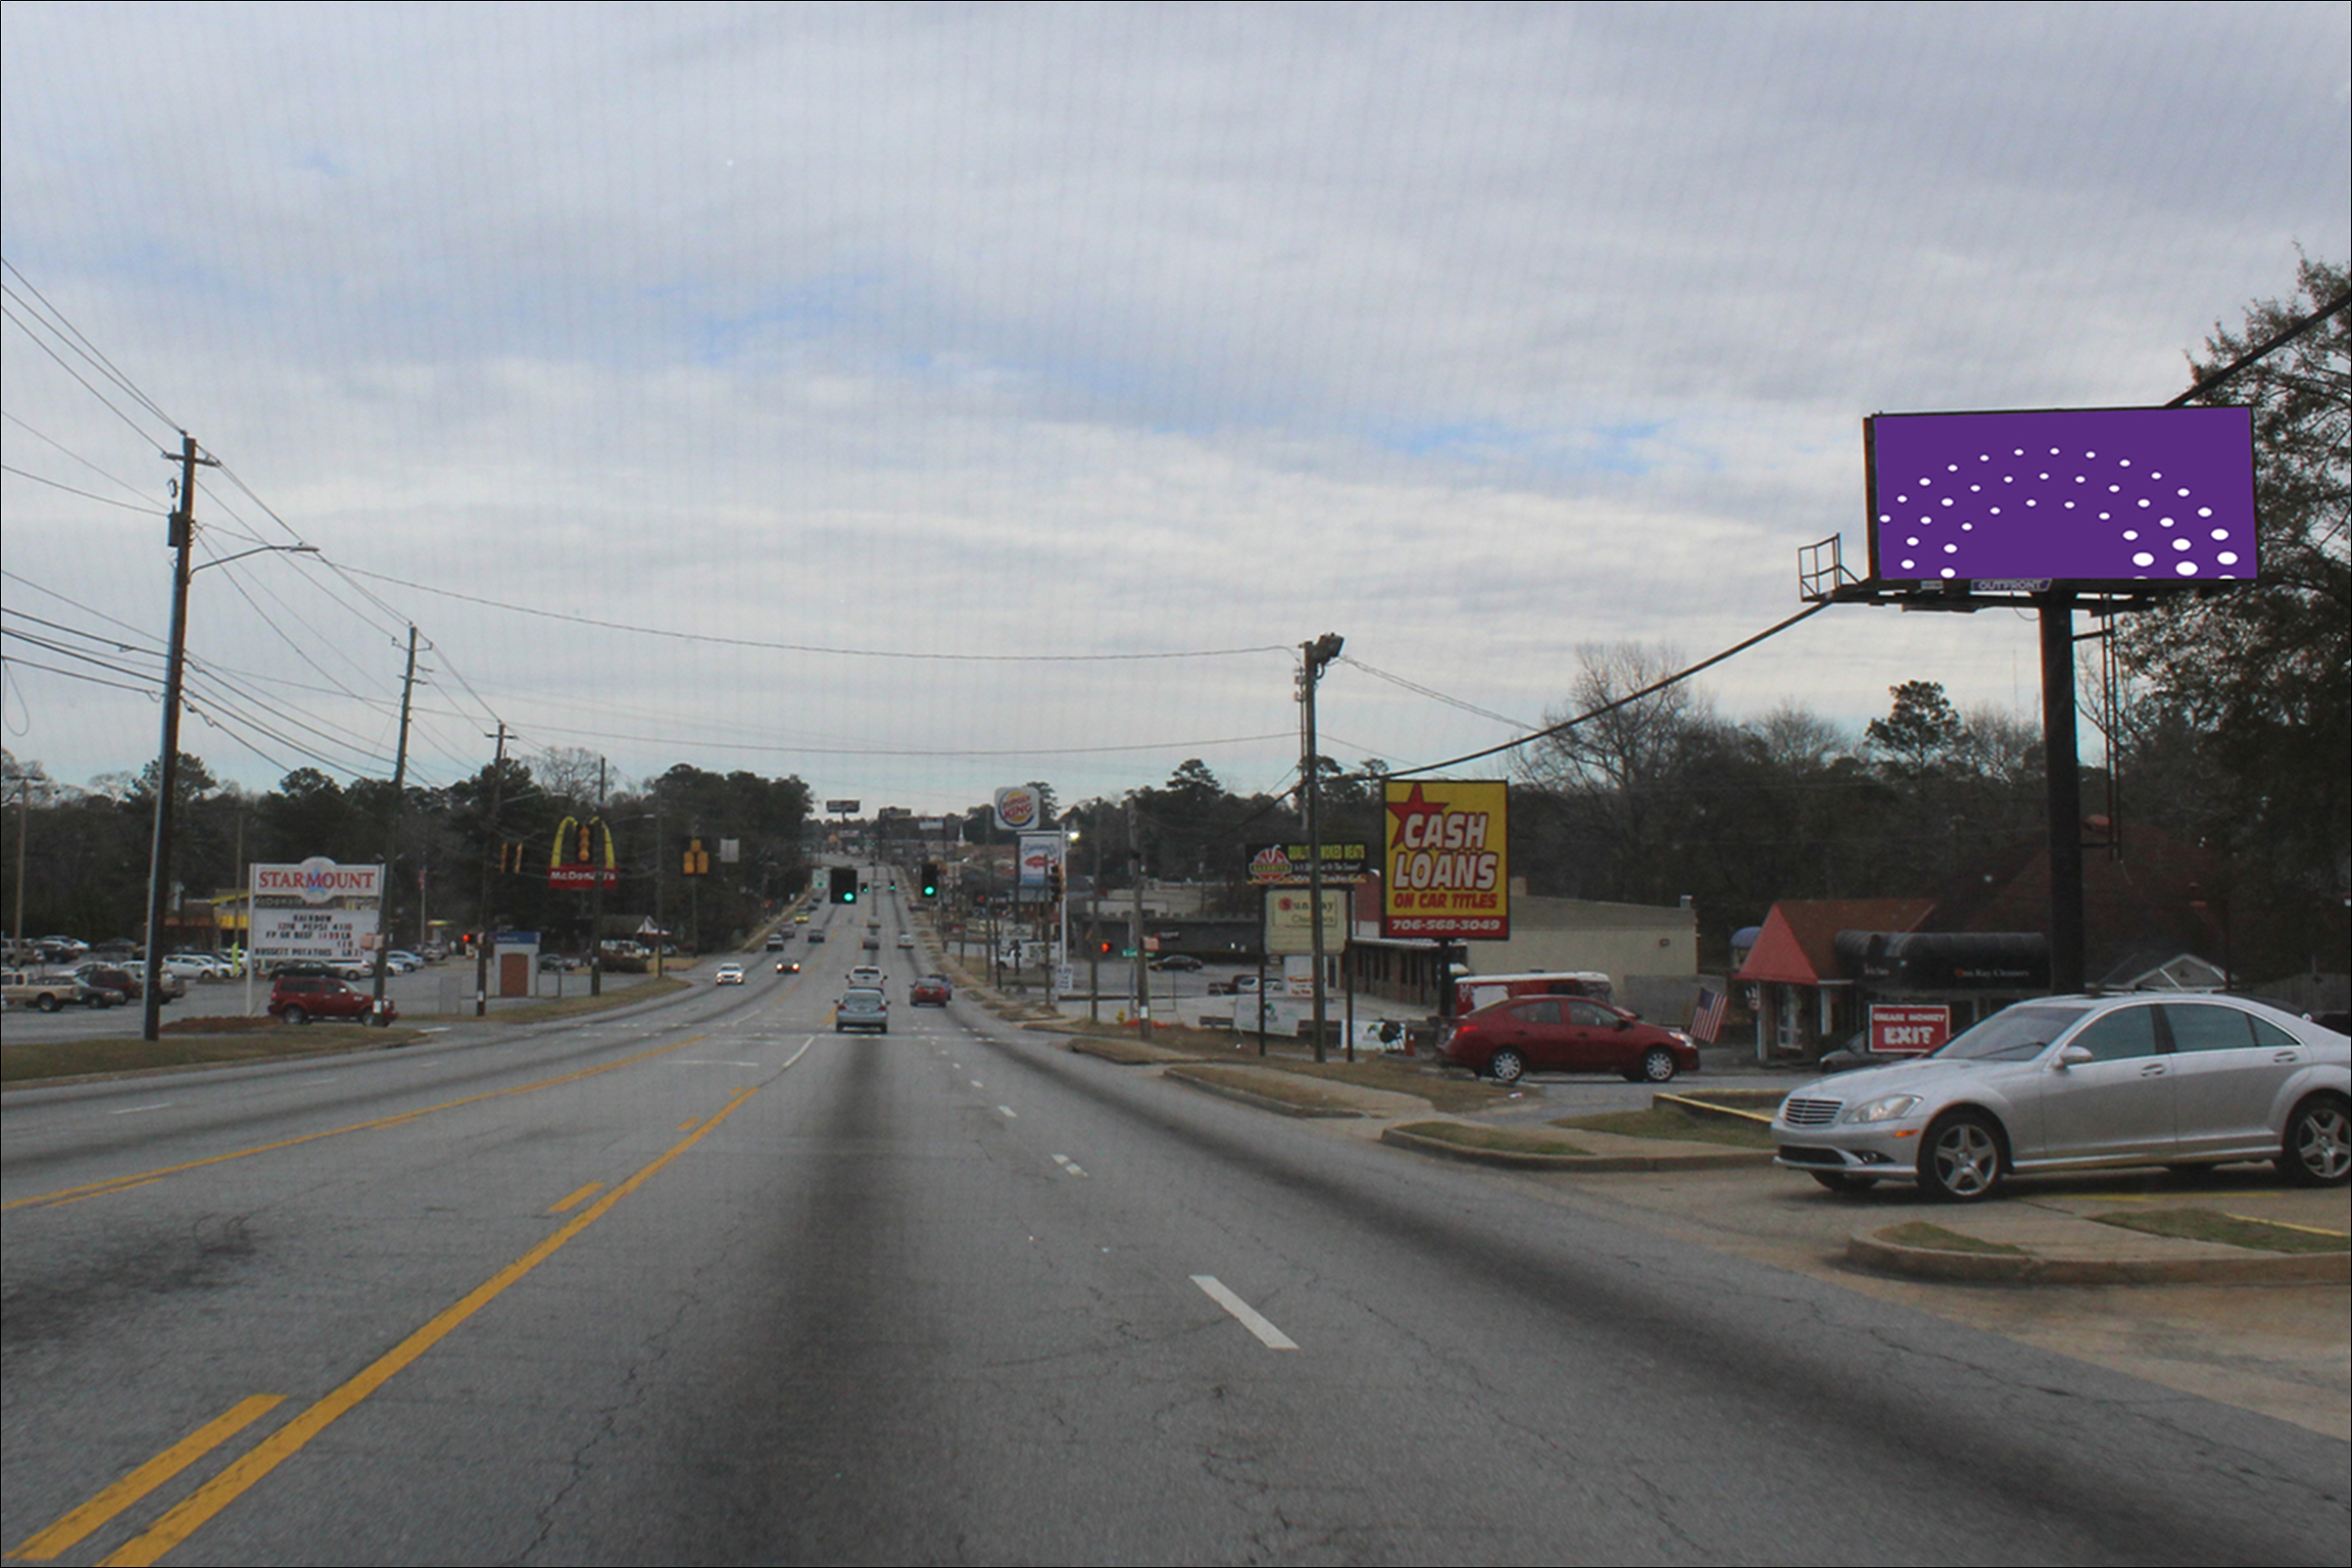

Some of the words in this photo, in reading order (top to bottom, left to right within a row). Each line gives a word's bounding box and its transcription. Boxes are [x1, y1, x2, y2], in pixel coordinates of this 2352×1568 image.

[1978, 578, 2043, 591] OUTFRONT
[1004, 803, 1033, 819] KING
[1403, 811, 1490, 851] CASH
[259, 871, 375, 888] STARMOUNT
[1393, 852, 1499, 892] LOANS
[1394, 893, 1414, 909] ON
[1418, 893, 1446, 909] CAR
[1451, 893, 1498, 910] TITLES
[1392, 918, 1501, 931] 706-568-3049
[1872, 1012, 1905, 1022] GREASE
[1908, 1012, 1945, 1022] MONKEY
[1884, 1026, 1935, 1045] EXIT
